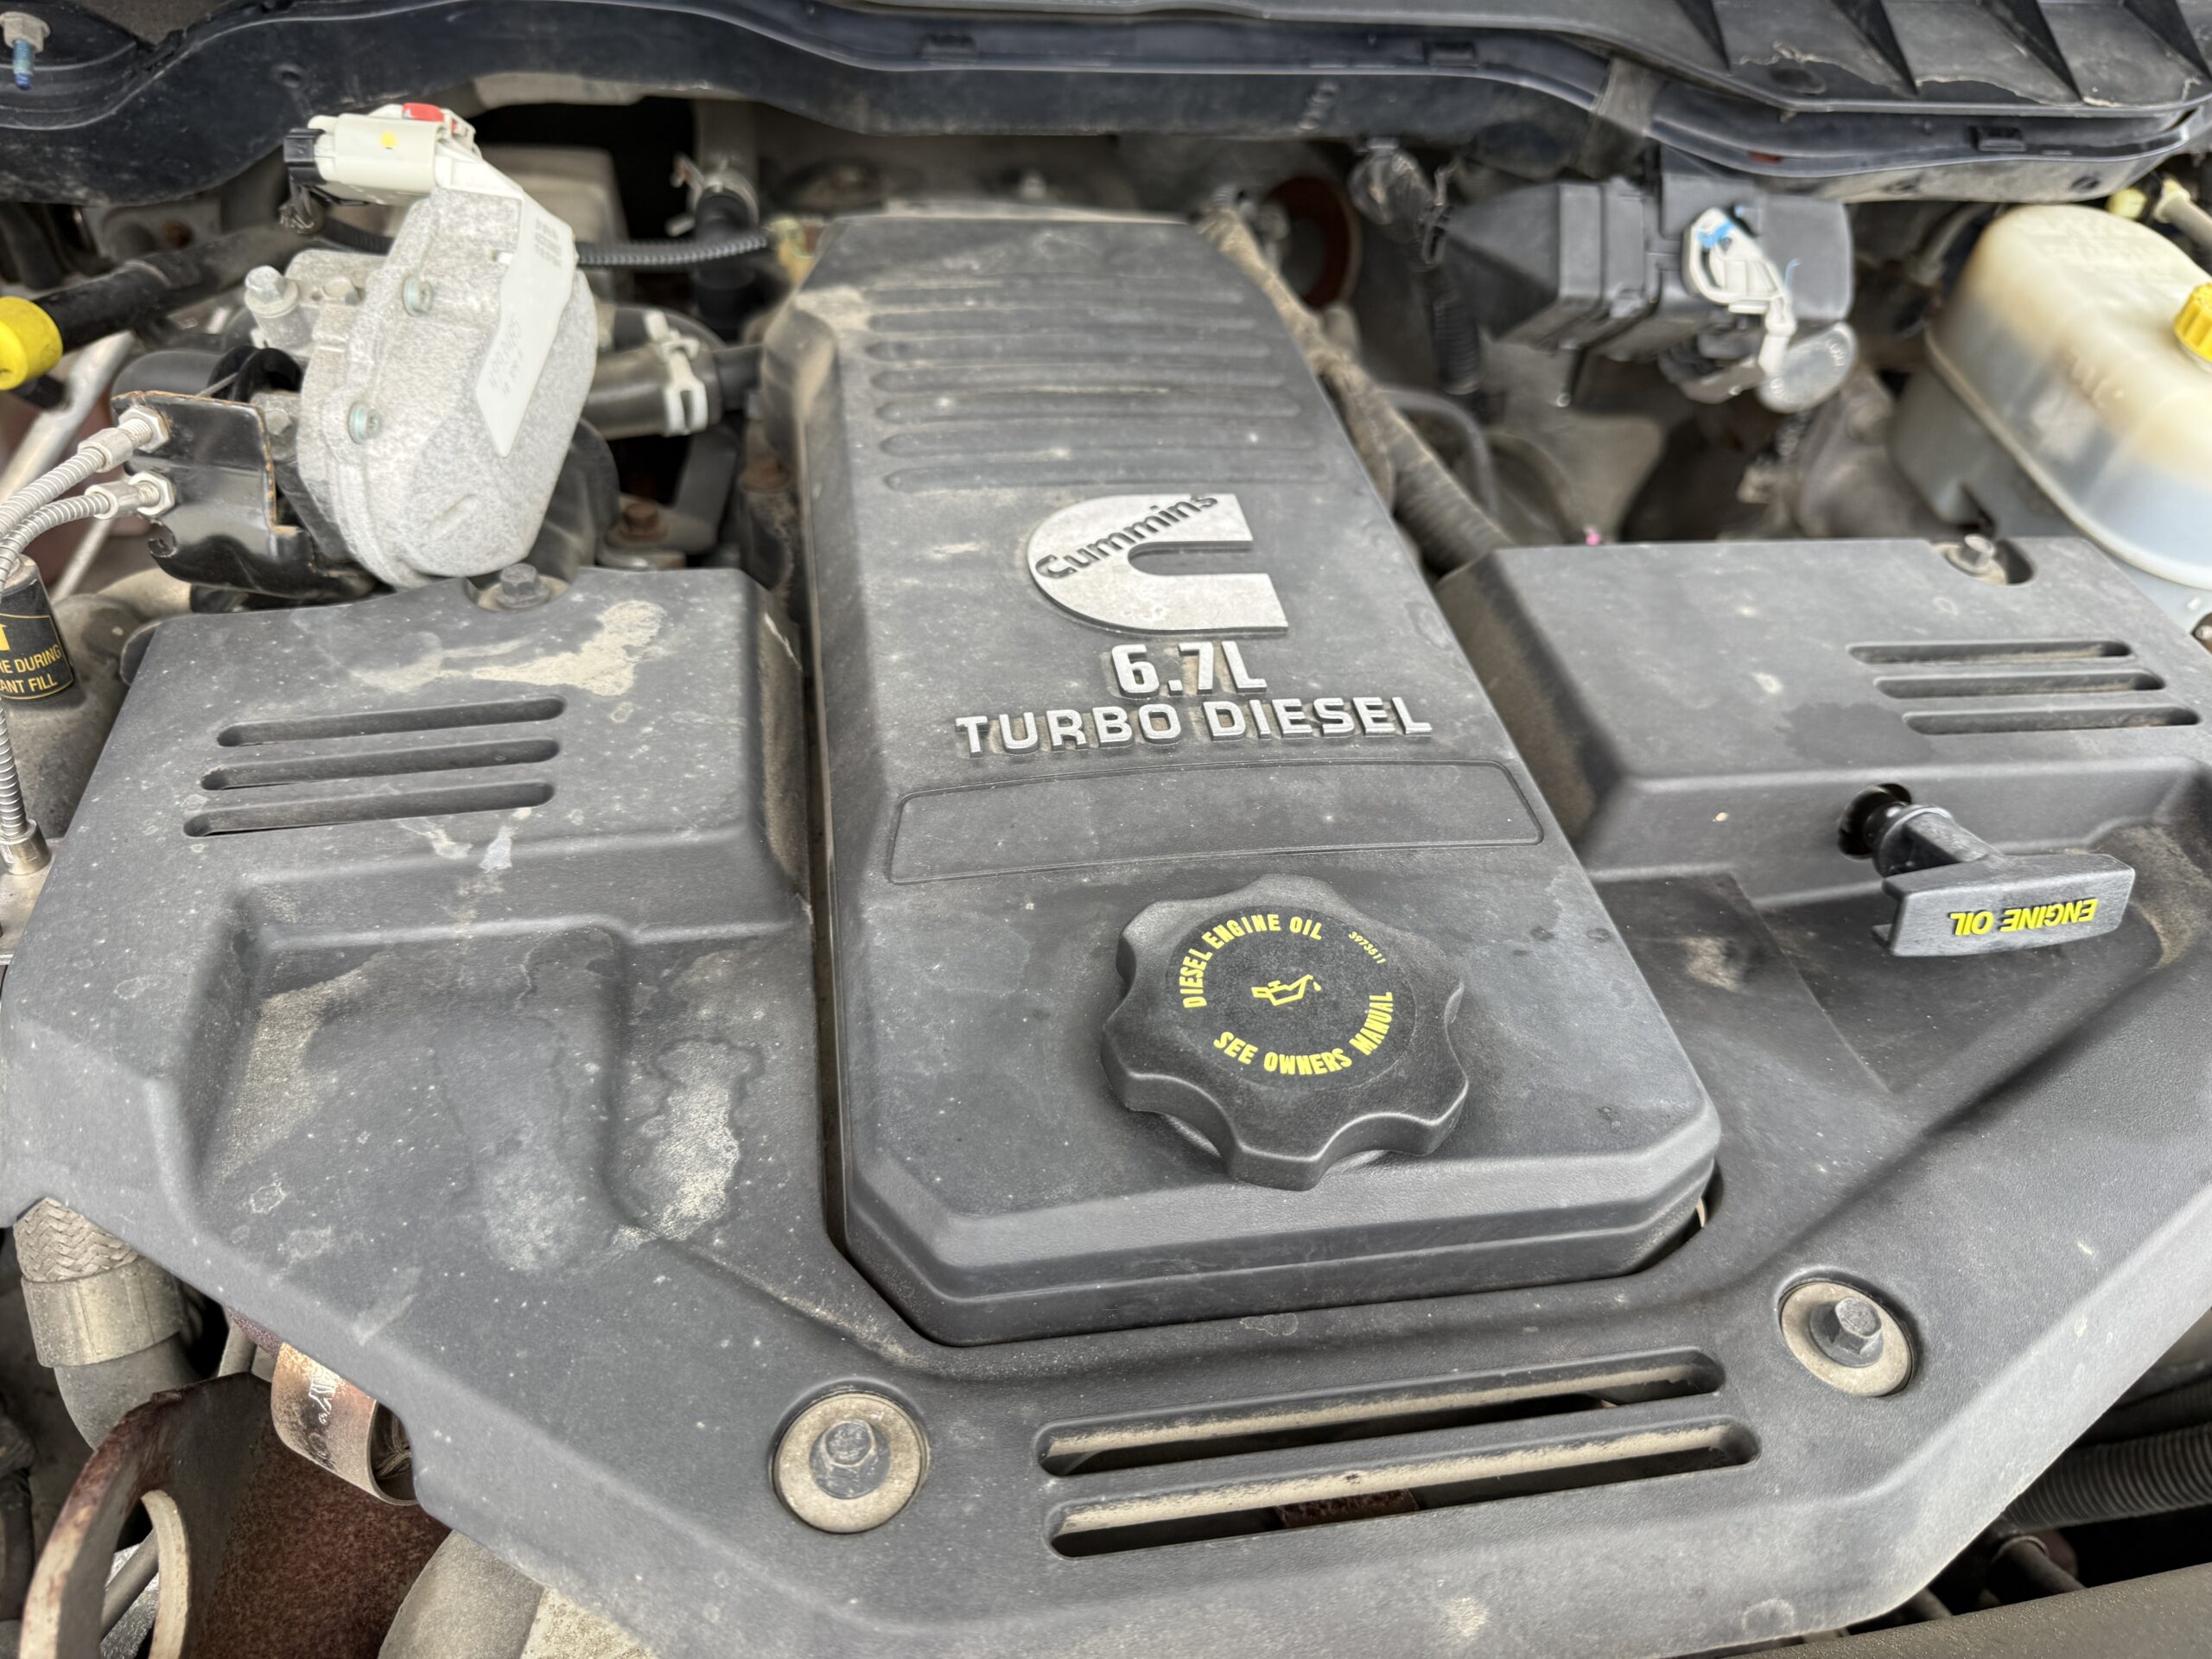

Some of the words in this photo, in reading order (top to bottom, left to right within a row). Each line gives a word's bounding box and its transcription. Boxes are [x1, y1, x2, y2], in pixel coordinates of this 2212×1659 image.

[1035, 492, 1219, 579] Cummins
[14, 644, 62, 674] DURING
[28, 673, 59, 692] FILL
[1109, 640, 1268, 698] 6.7L
[955, 702, 1183, 757] TURBO
[1202, 696, 1433, 741] DIESEL
[1949, 911, 1994, 937] OIL
[1999, 898, 2100, 933] ENGINE
[1179, 948, 1213, 1009] DIESEL
[1201, 913, 1281, 950] ENGINE
[1289, 916, 1324, 941] OIL
[1213, 1031, 1259, 1065] SEE
[1263, 1047, 1353, 1076] OWNERS
[1349, 991, 1395, 1057] MANUAL
